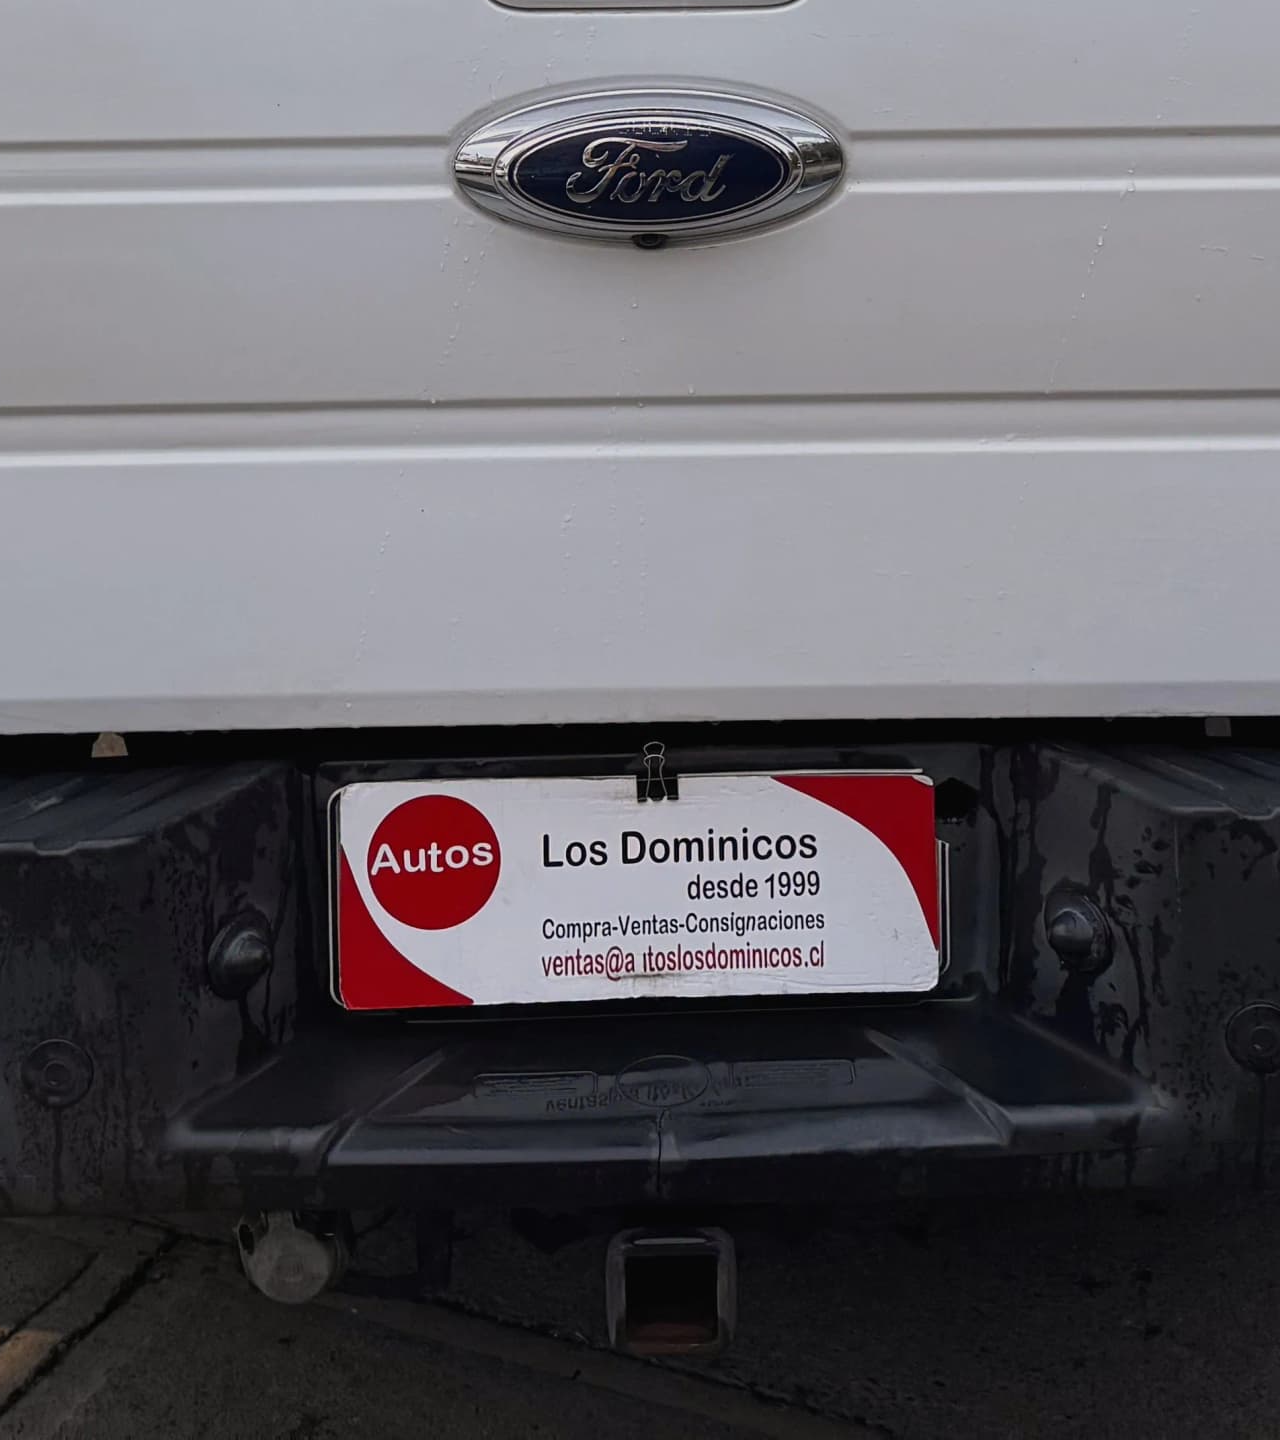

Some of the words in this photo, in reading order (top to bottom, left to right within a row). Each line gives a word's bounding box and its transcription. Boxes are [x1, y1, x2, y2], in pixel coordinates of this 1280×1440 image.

[565, 136, 737, 204] Ford
[370, 841, 495, 876] Autos
[542, 833, 609, 868] Los
[620, 826, 819, 865] Dominicos
[686, 871, 759, 900] desde
[764, 869, 821, 899] 1999
[541, 909, 826, 943] Compra-Ventas-Consignaciones
